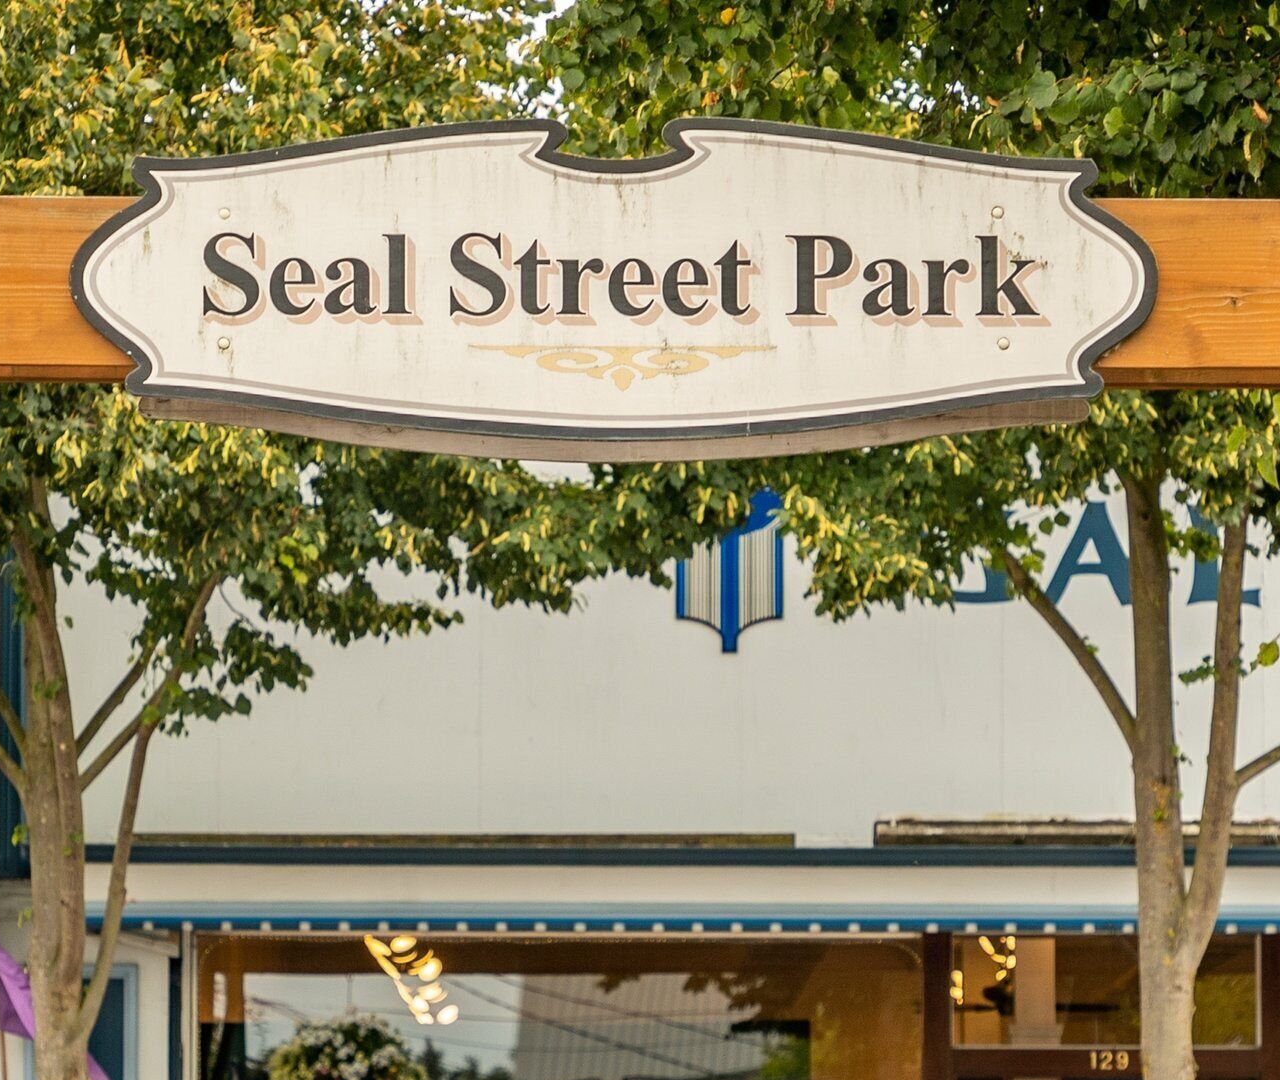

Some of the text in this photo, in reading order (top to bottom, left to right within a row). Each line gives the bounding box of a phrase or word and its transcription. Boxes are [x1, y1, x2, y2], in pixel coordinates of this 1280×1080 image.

[203, 231, 1048, 325] Seal Street Park
[1089, 1051, 1129, 1071] 129
